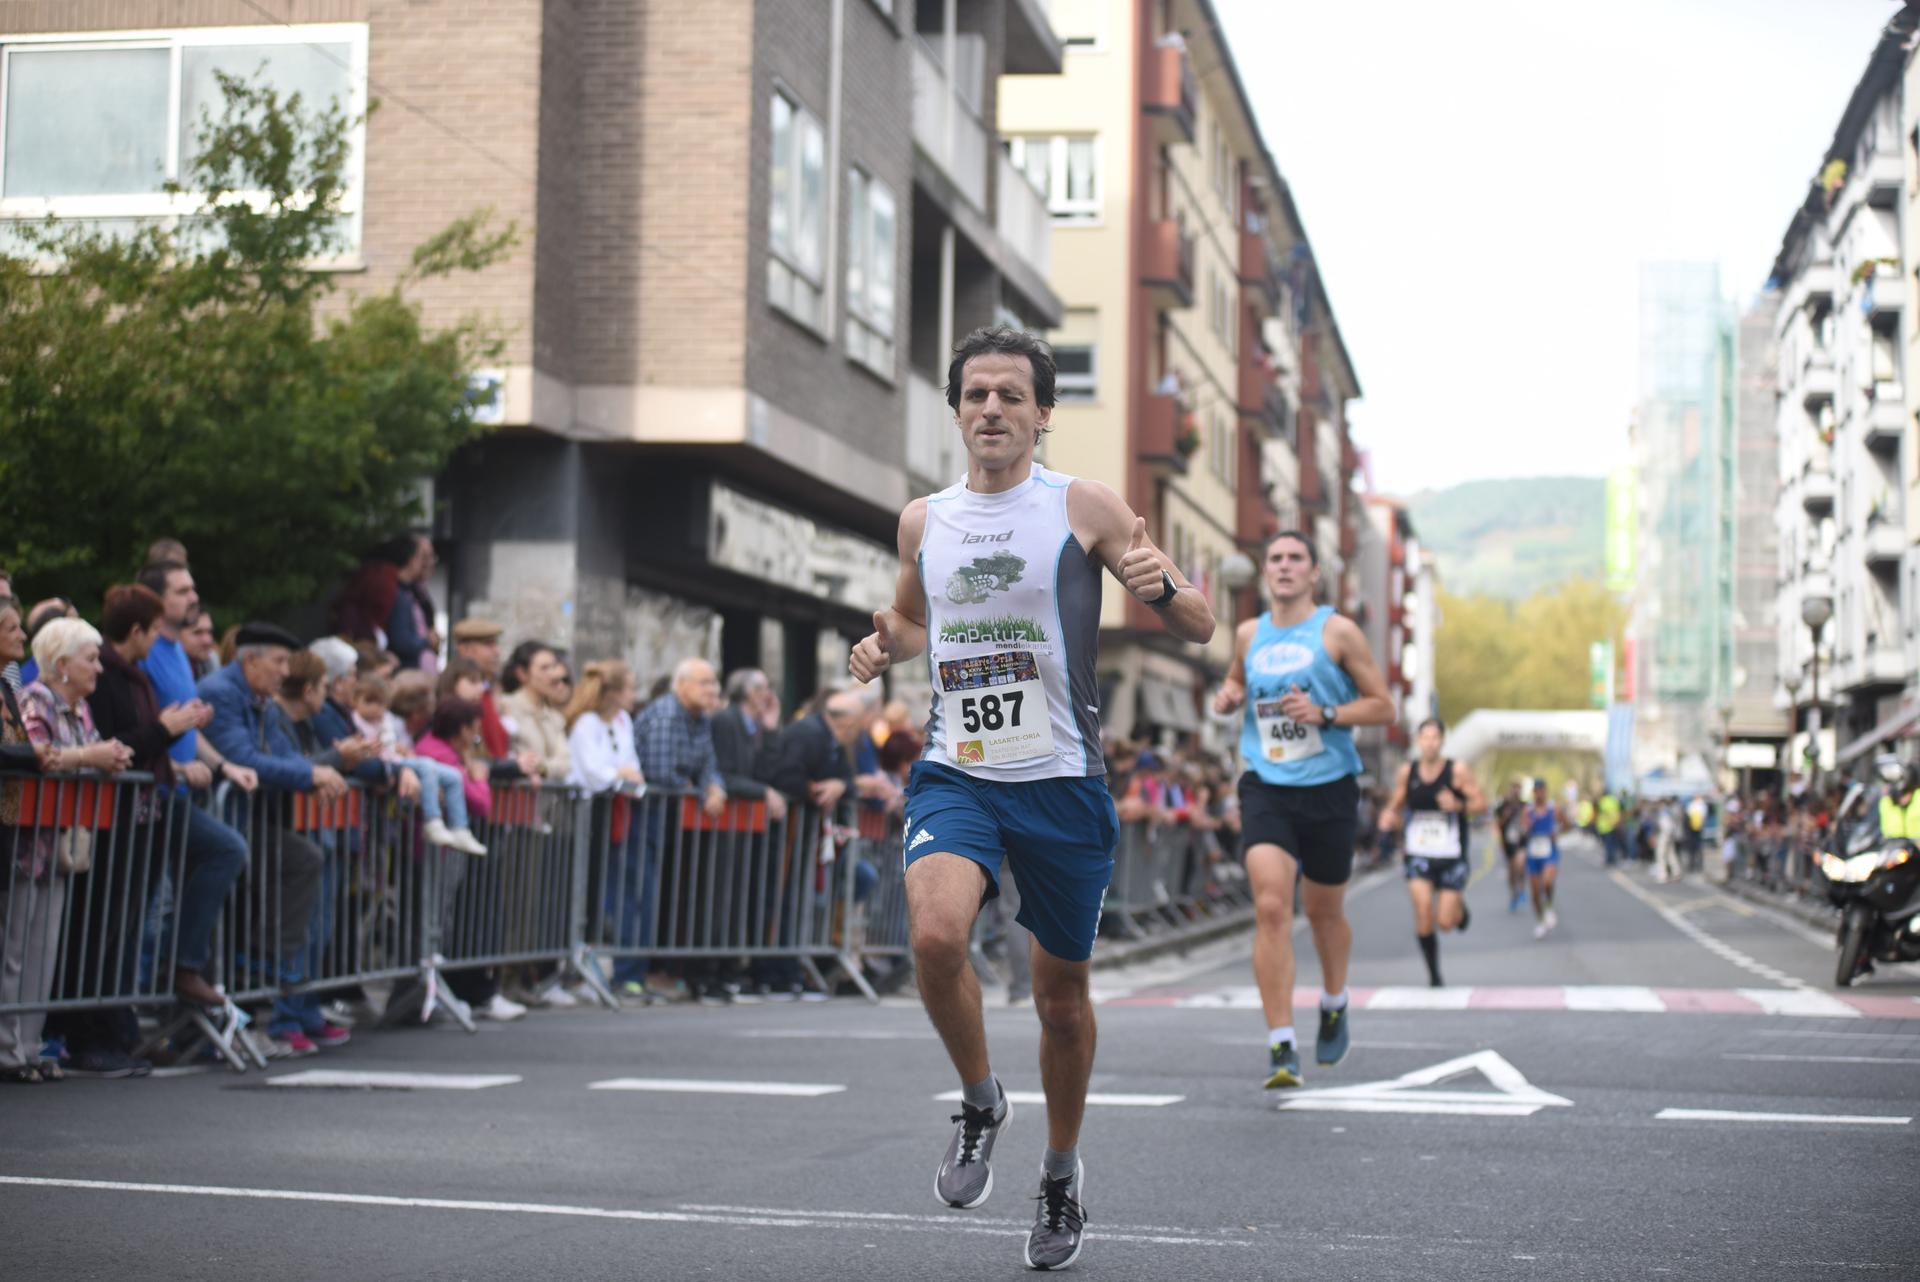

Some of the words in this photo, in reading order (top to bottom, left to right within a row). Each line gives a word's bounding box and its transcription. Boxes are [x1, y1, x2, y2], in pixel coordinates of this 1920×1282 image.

[961, 529, 1015, 545] land
[961, 690, 1024, 734] 587
[1270, 721, 1307, 741] 466
